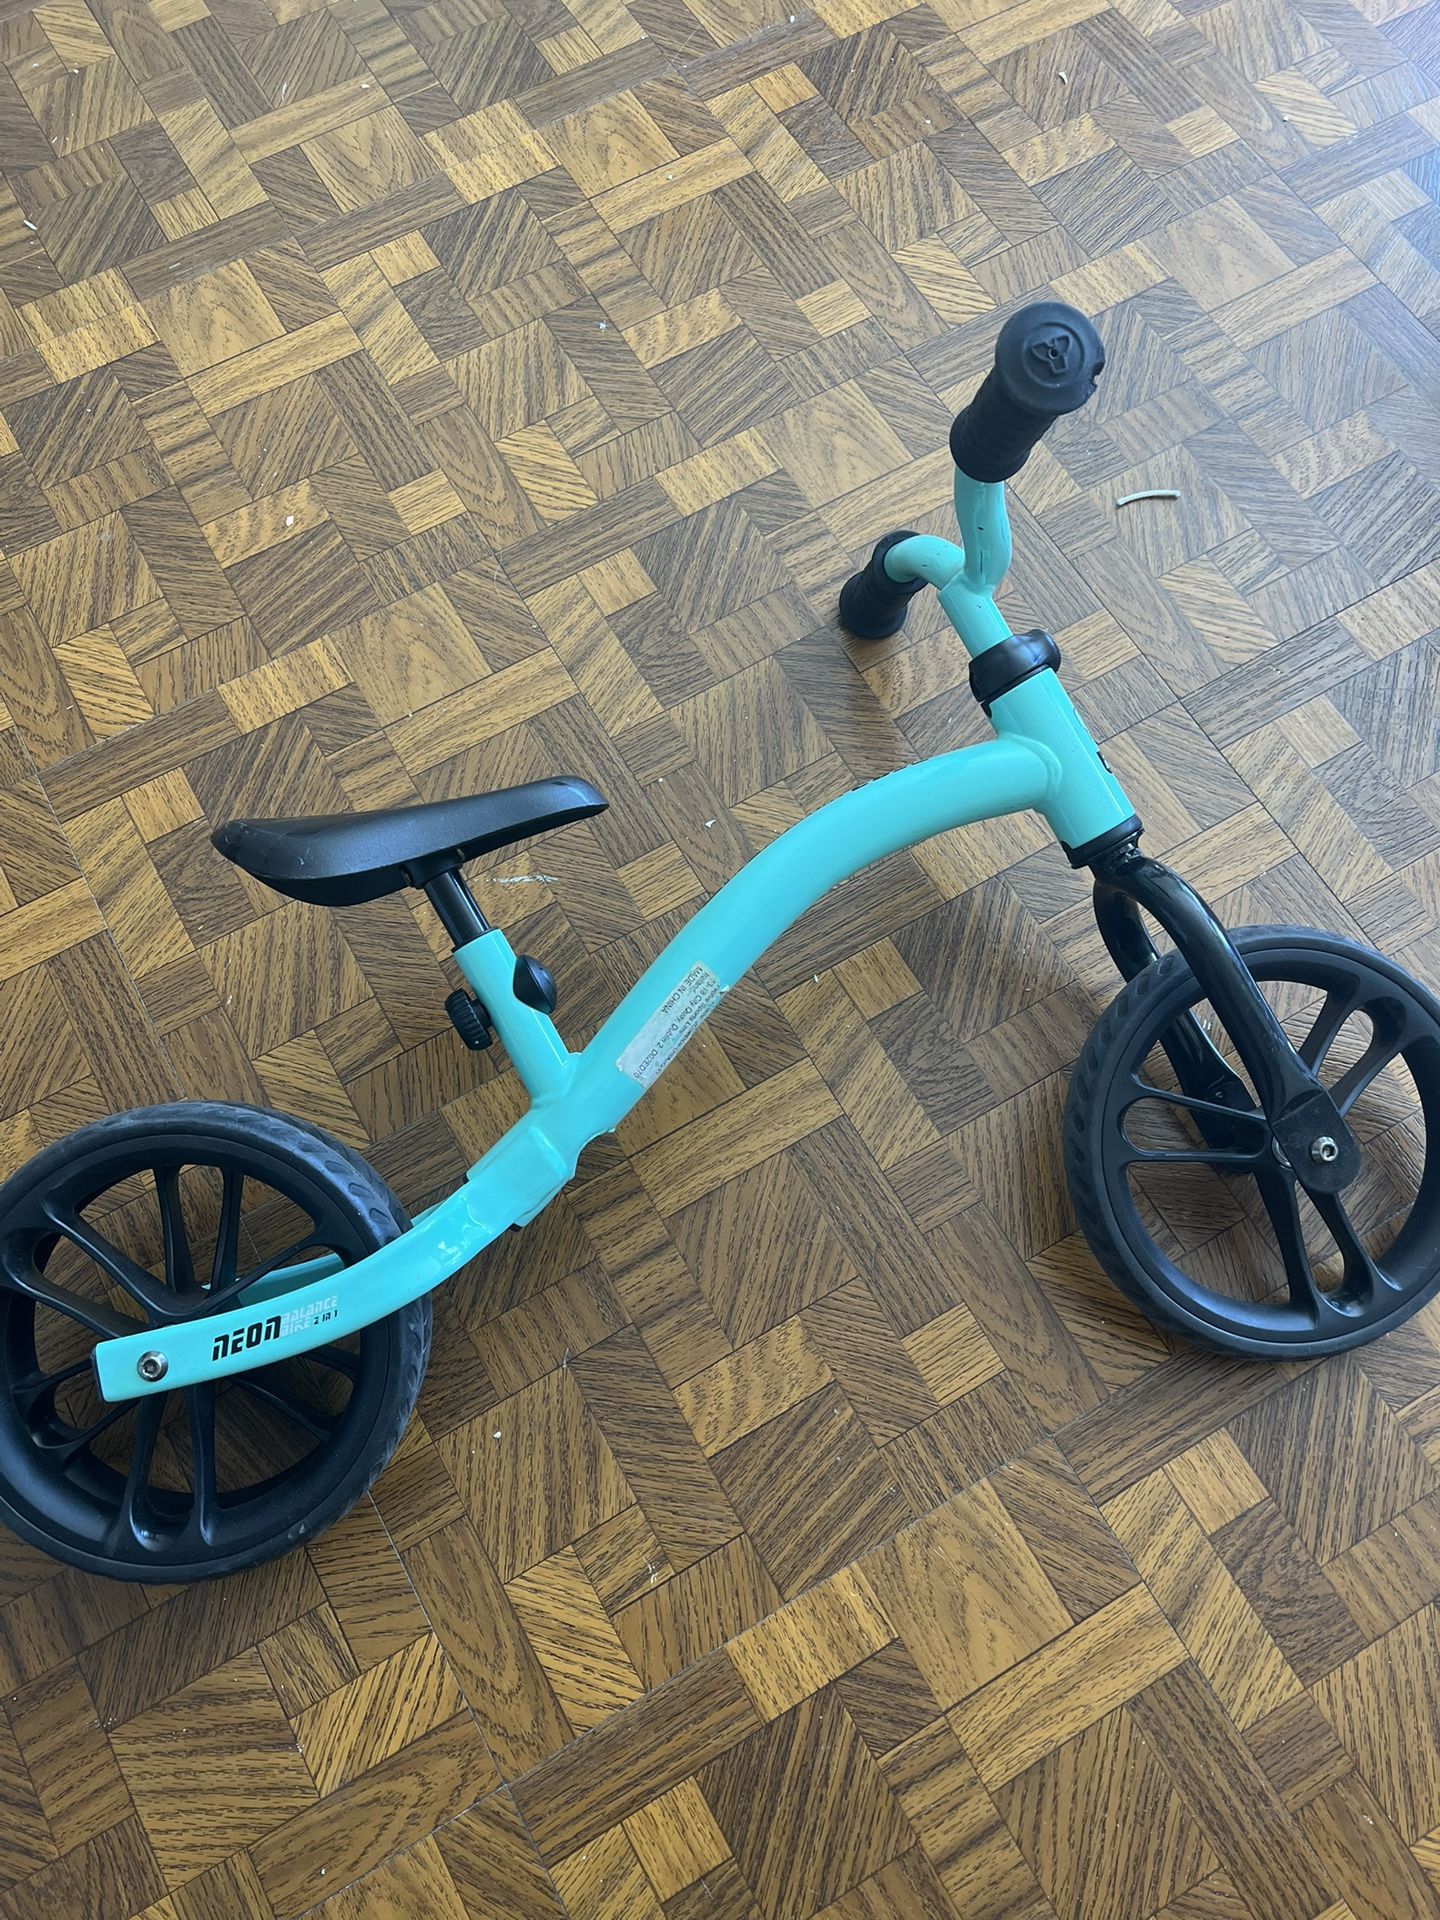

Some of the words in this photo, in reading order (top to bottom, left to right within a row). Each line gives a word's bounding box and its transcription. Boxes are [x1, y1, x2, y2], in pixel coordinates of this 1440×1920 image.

[686, 966, 703, 986] MADE
[677, 983, 687, 994] IN
[661, 993, 681, 1014] CHINA
[689, 995, 702, 1007] City
[690, 1002, 705, 1022] Sports
[661, 1022, 679, 1043] Dublin
[633, 1049, 658, 1078] D02ED70
[281, 1295, 338, 1322] BALANCE
[281, 1317, 311, 1338] BIKE
[314, 1316, 320, 1325] 2
